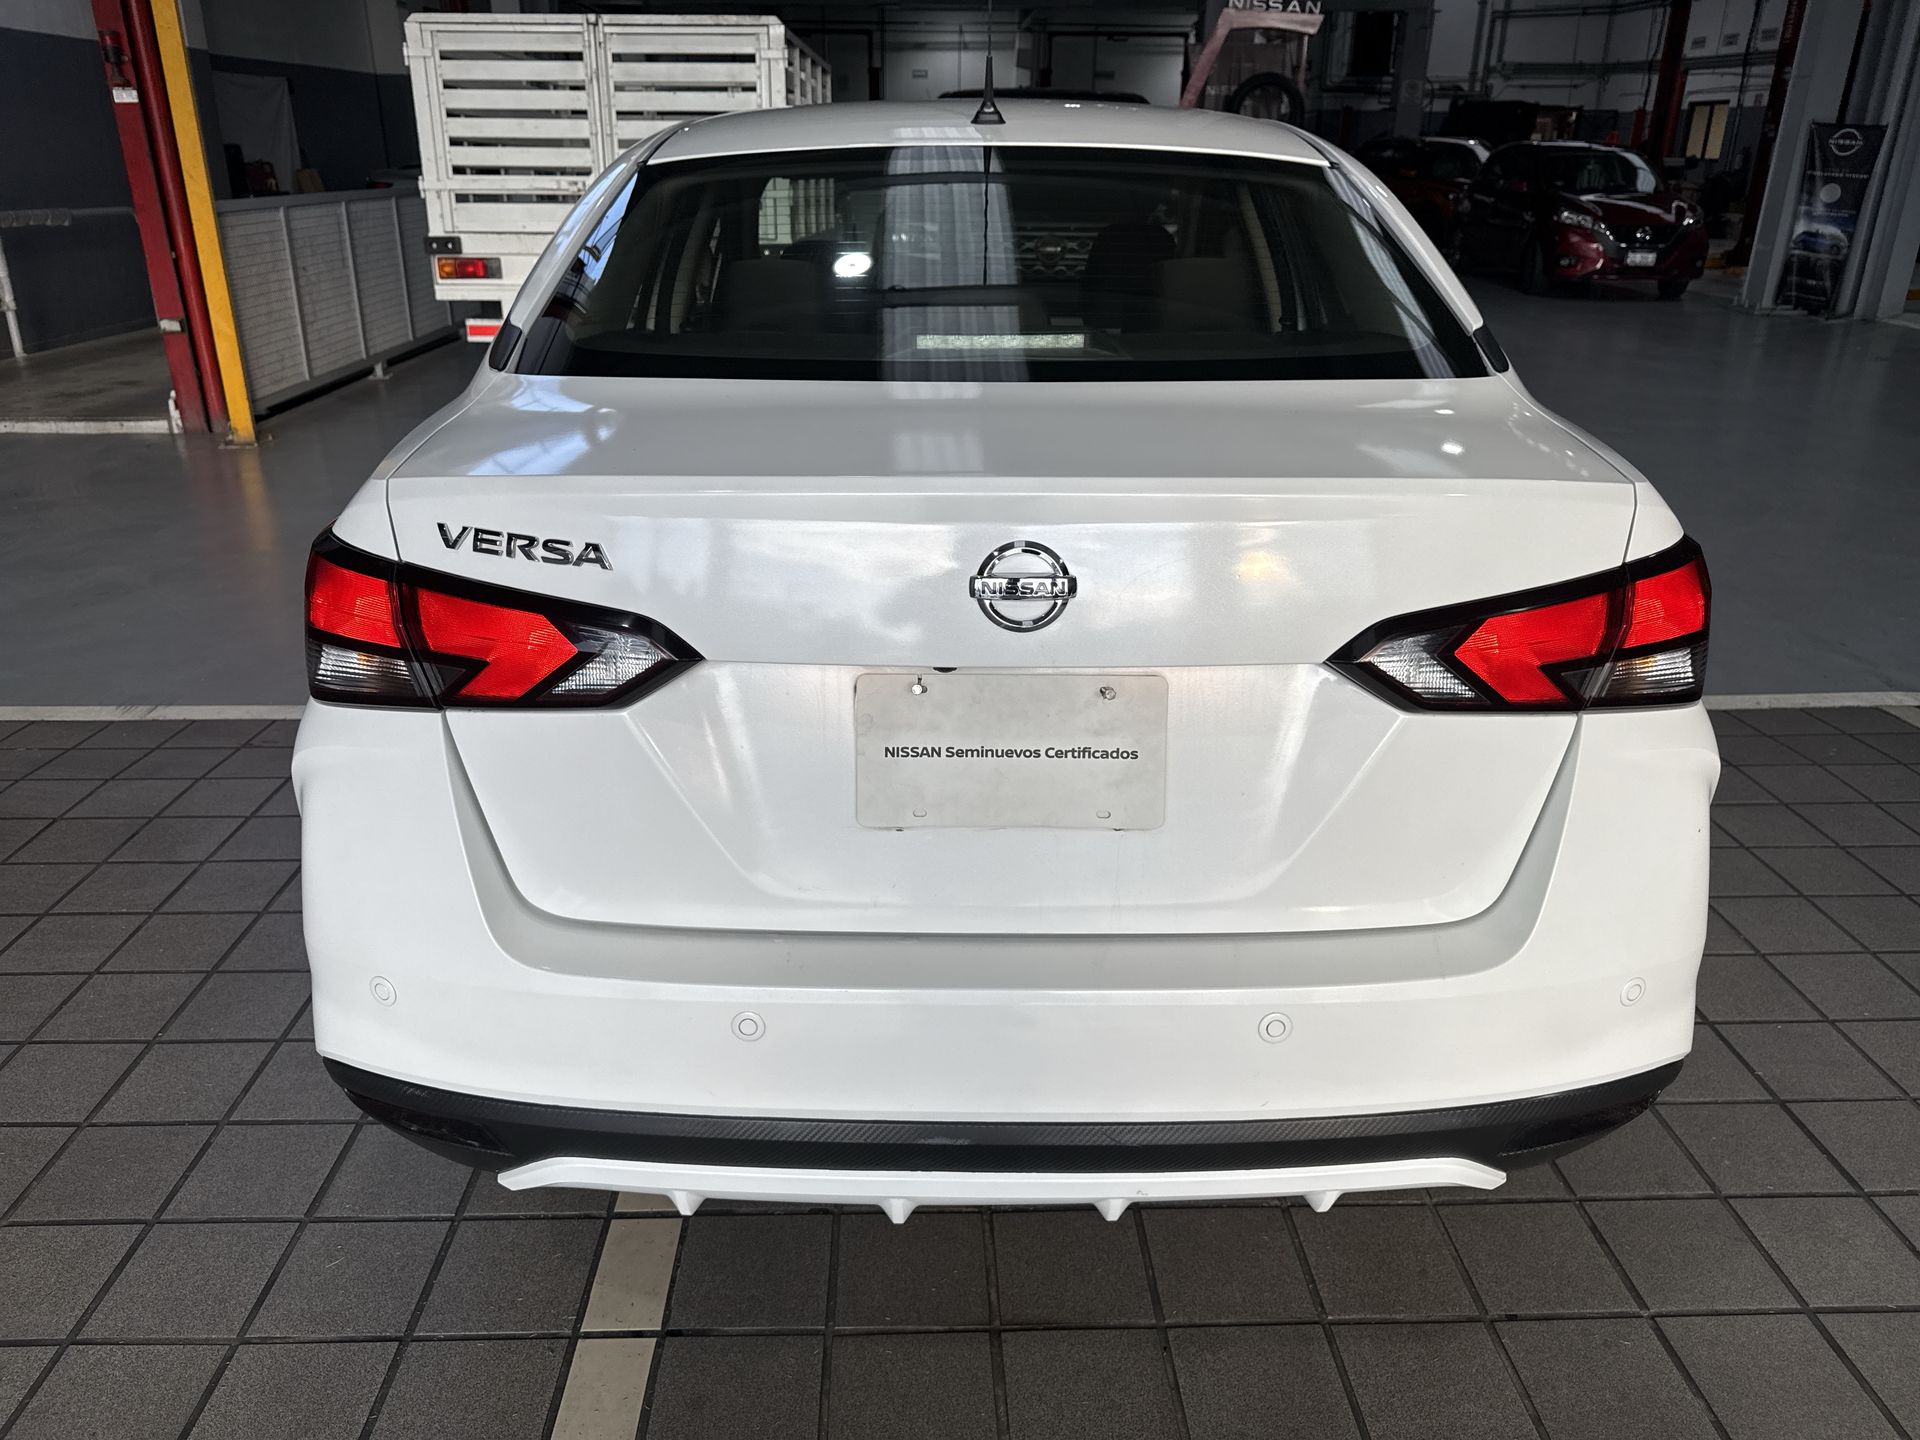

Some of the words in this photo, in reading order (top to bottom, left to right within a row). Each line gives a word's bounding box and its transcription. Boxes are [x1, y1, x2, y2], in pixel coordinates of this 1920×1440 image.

[1228, 0, 1321, 14] NISSAN
[436, 522, 614, 571] VERSA
[981, 581, 1066, 596] NISSAN
[884, 746, 942, 758] NISSAN
[945, 746, 1041, 759] Seminuevos
[1044, 746, 1139, 760] Certificados
